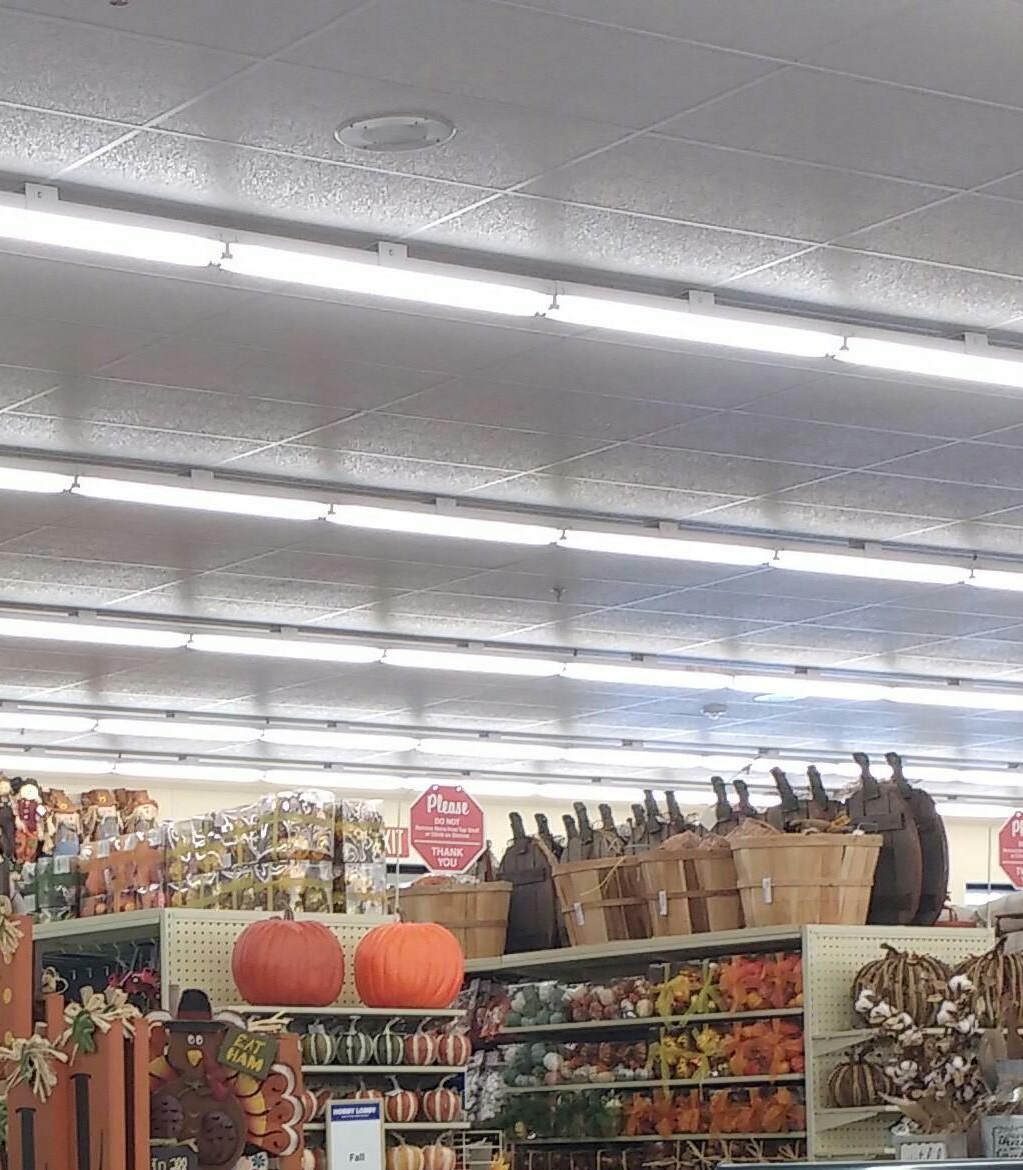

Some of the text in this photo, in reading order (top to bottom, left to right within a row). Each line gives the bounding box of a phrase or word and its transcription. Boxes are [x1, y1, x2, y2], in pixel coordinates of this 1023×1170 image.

[427, 793, 470, 815] Please
[434, 817, 445, 825] DO
[431, 846, 464, 857] THANK
[437, 858, 458, 867] YOU
[233, 1033, 266, 1050] EAT
[225, 1048, 265, 1073] HAM
[349, 1152, 366, 1162] Fall
